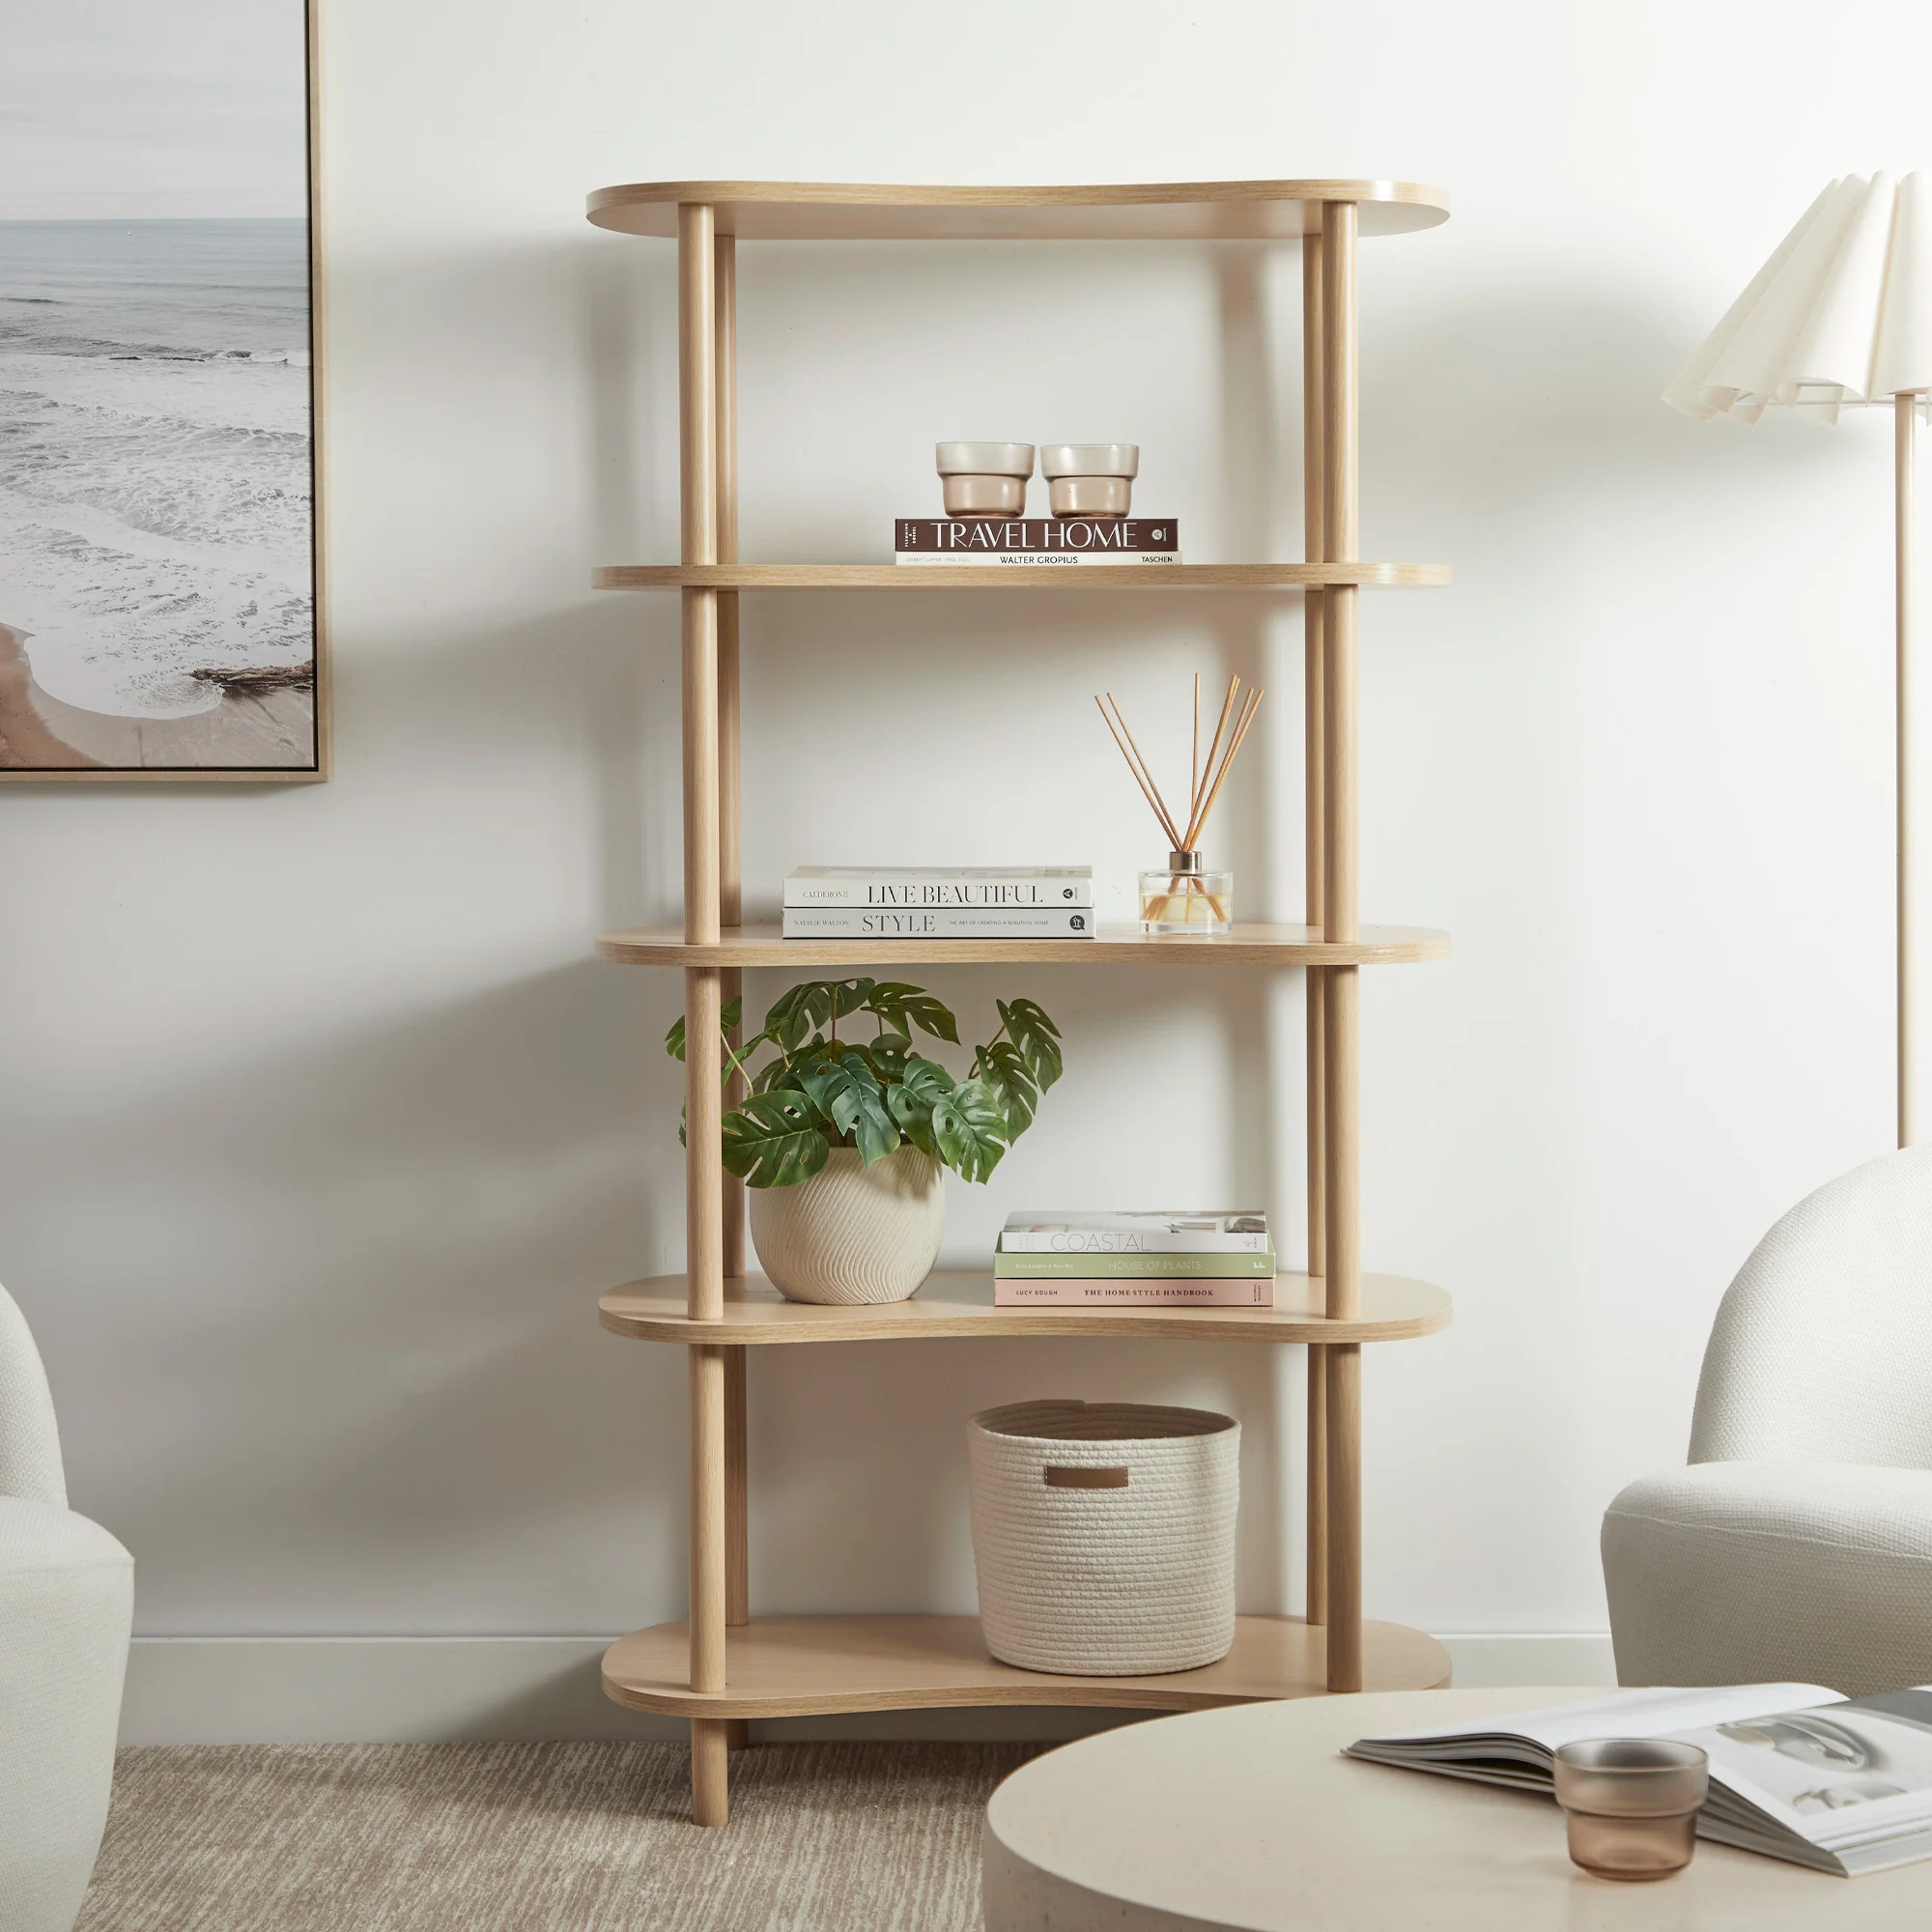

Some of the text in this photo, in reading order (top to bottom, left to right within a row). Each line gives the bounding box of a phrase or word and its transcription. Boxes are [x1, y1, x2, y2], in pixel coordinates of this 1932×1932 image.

[930, 523, 1036, 548] TRAVEL
[1044, 523, 1138, 548] HOME
[867, 886, 1043, 903] LIVE BEAUTIFUL
[862, 915, 936, 931] STYLE
[1050, 1233, 1151, 1251] COASTAL
[1109, 1261, 1202, 1270] HOUSE OF PLANTS
